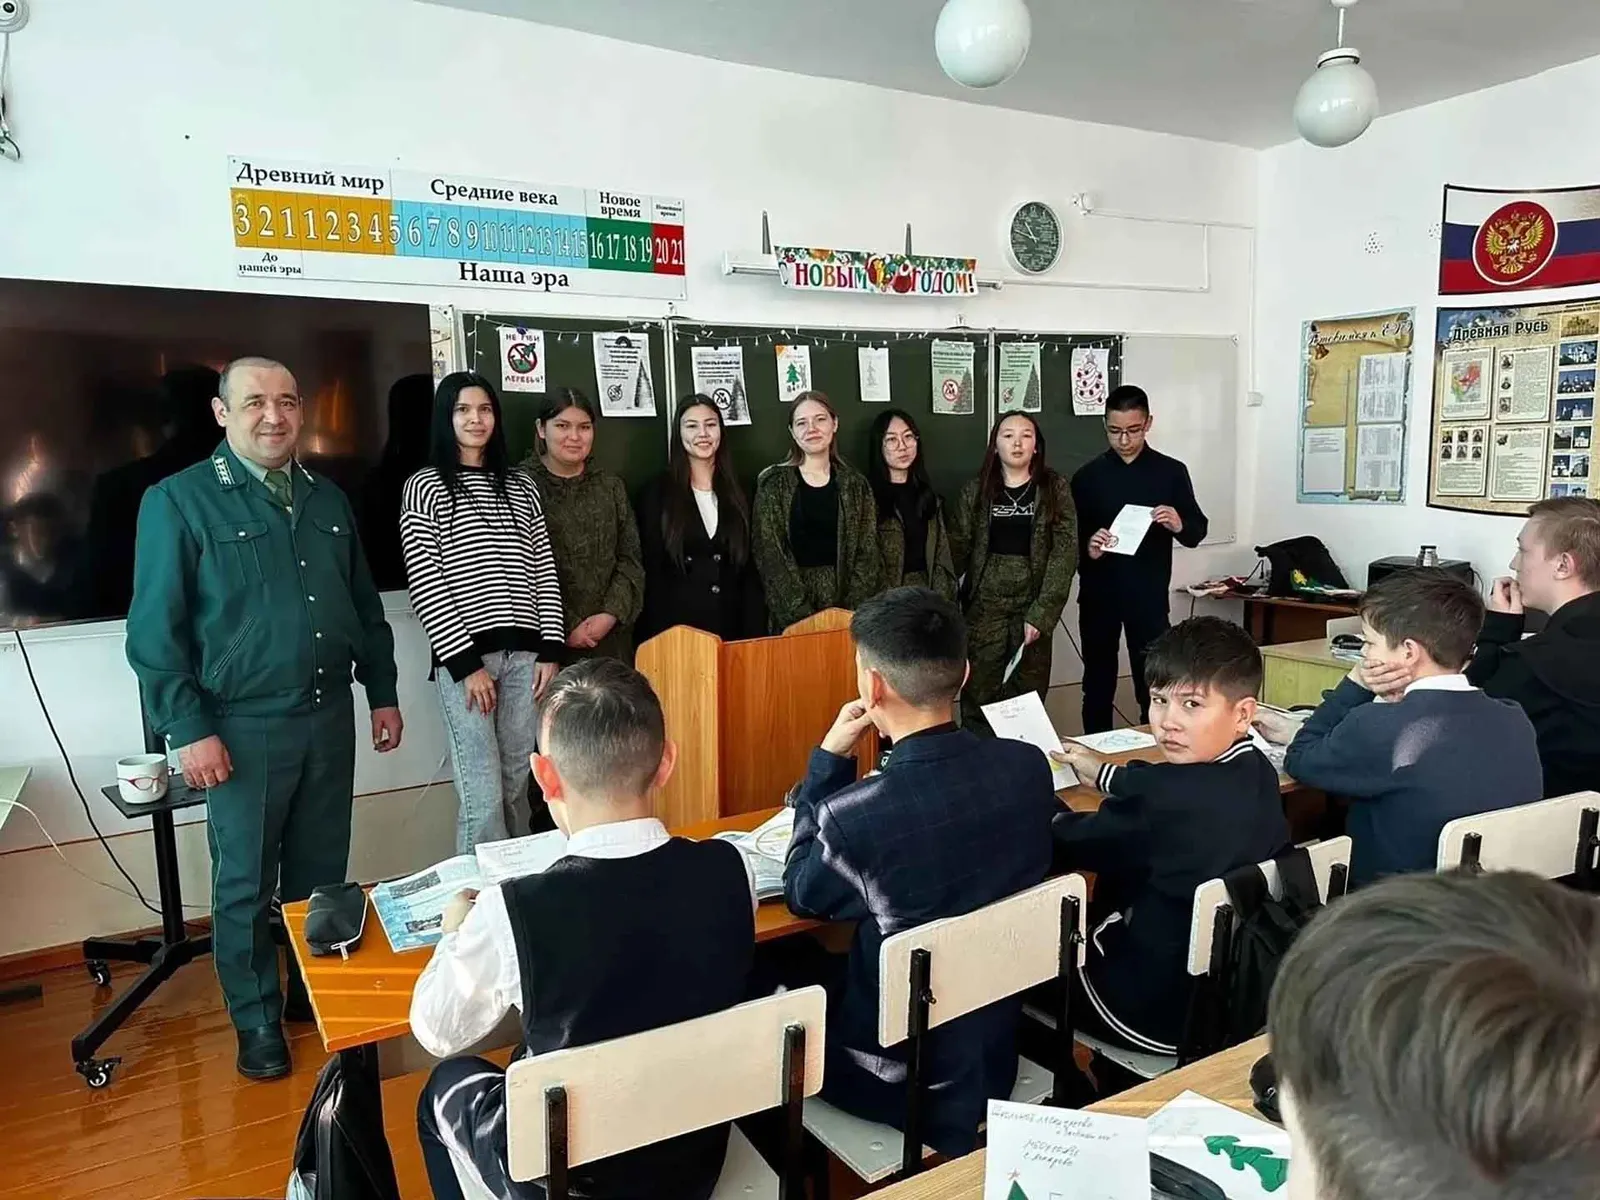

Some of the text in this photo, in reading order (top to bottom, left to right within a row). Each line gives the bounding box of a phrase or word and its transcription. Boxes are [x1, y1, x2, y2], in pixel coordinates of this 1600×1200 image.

[236, 162, 385, 195] Древний мир
[430, 178, 559, 206] Средние века
[599, 191, 641, 208] Новое
[601, 205, 641, 218] время
[235, 203, 684, 265] 3 2 1 1 2 3 4 5 6 7 8 9 10 11 12 13 14 15 16 17 18 19 20 21
[239, 262, 301, 276] нашей эры
[262, 252, 279, 264] До
[459, 261, 570, 292] Наша эра
[795, 262, 867, 289] НОВЫМ
[911, 269, 975, 294] ГОДОМ!
[1452, 320, 1549, 341] Древняя Русь
